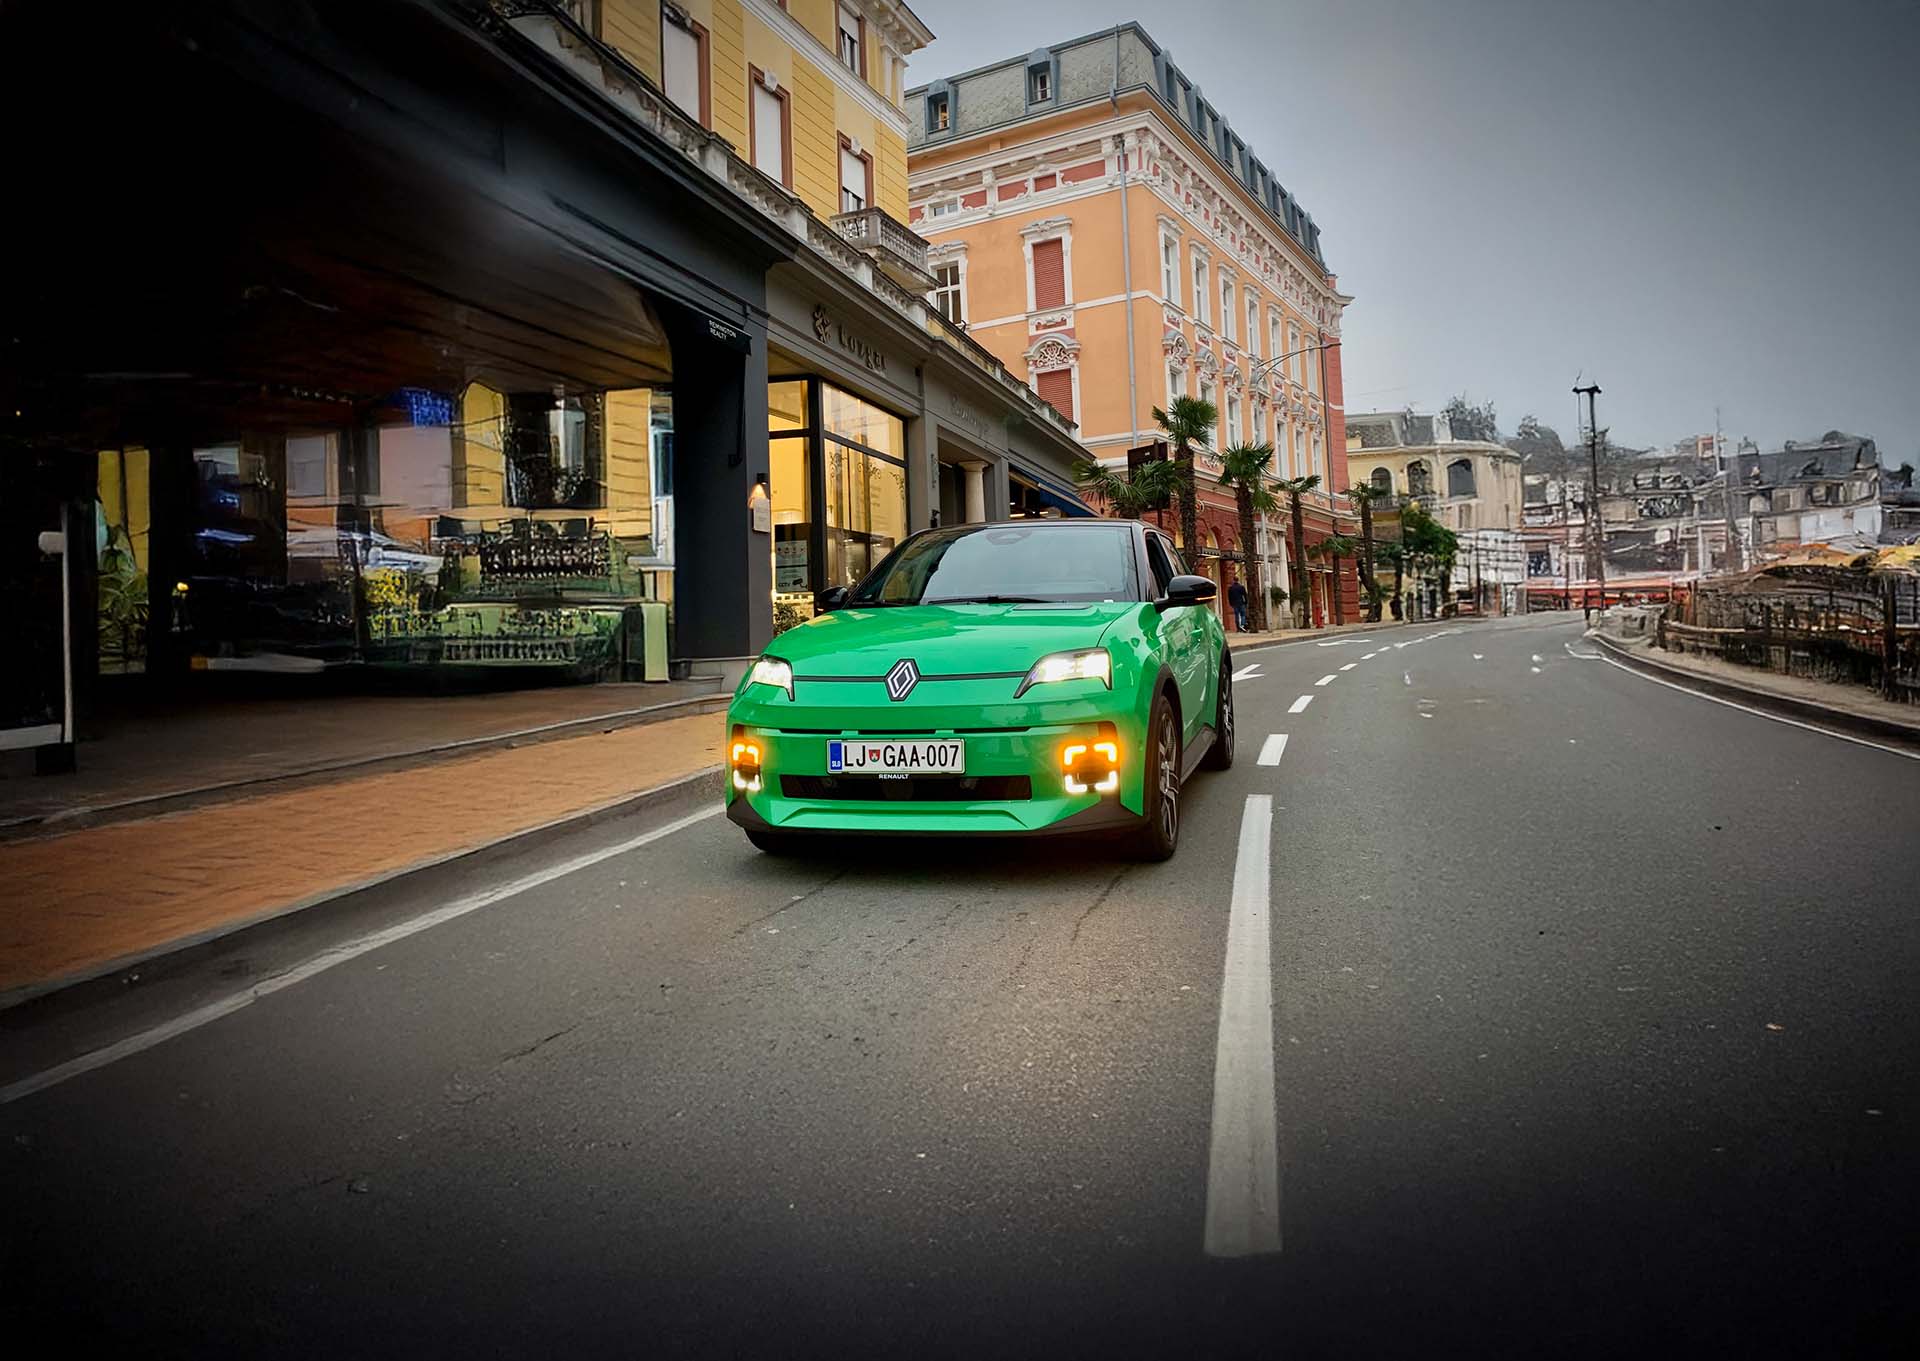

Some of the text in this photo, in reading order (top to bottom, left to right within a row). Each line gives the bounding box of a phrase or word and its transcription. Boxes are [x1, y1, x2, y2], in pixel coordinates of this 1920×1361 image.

[710, 327, 727, 340] REALTY
[844, 745, 960, 767] LJ GAA-007
[831, 760, 841, 768] SLO
